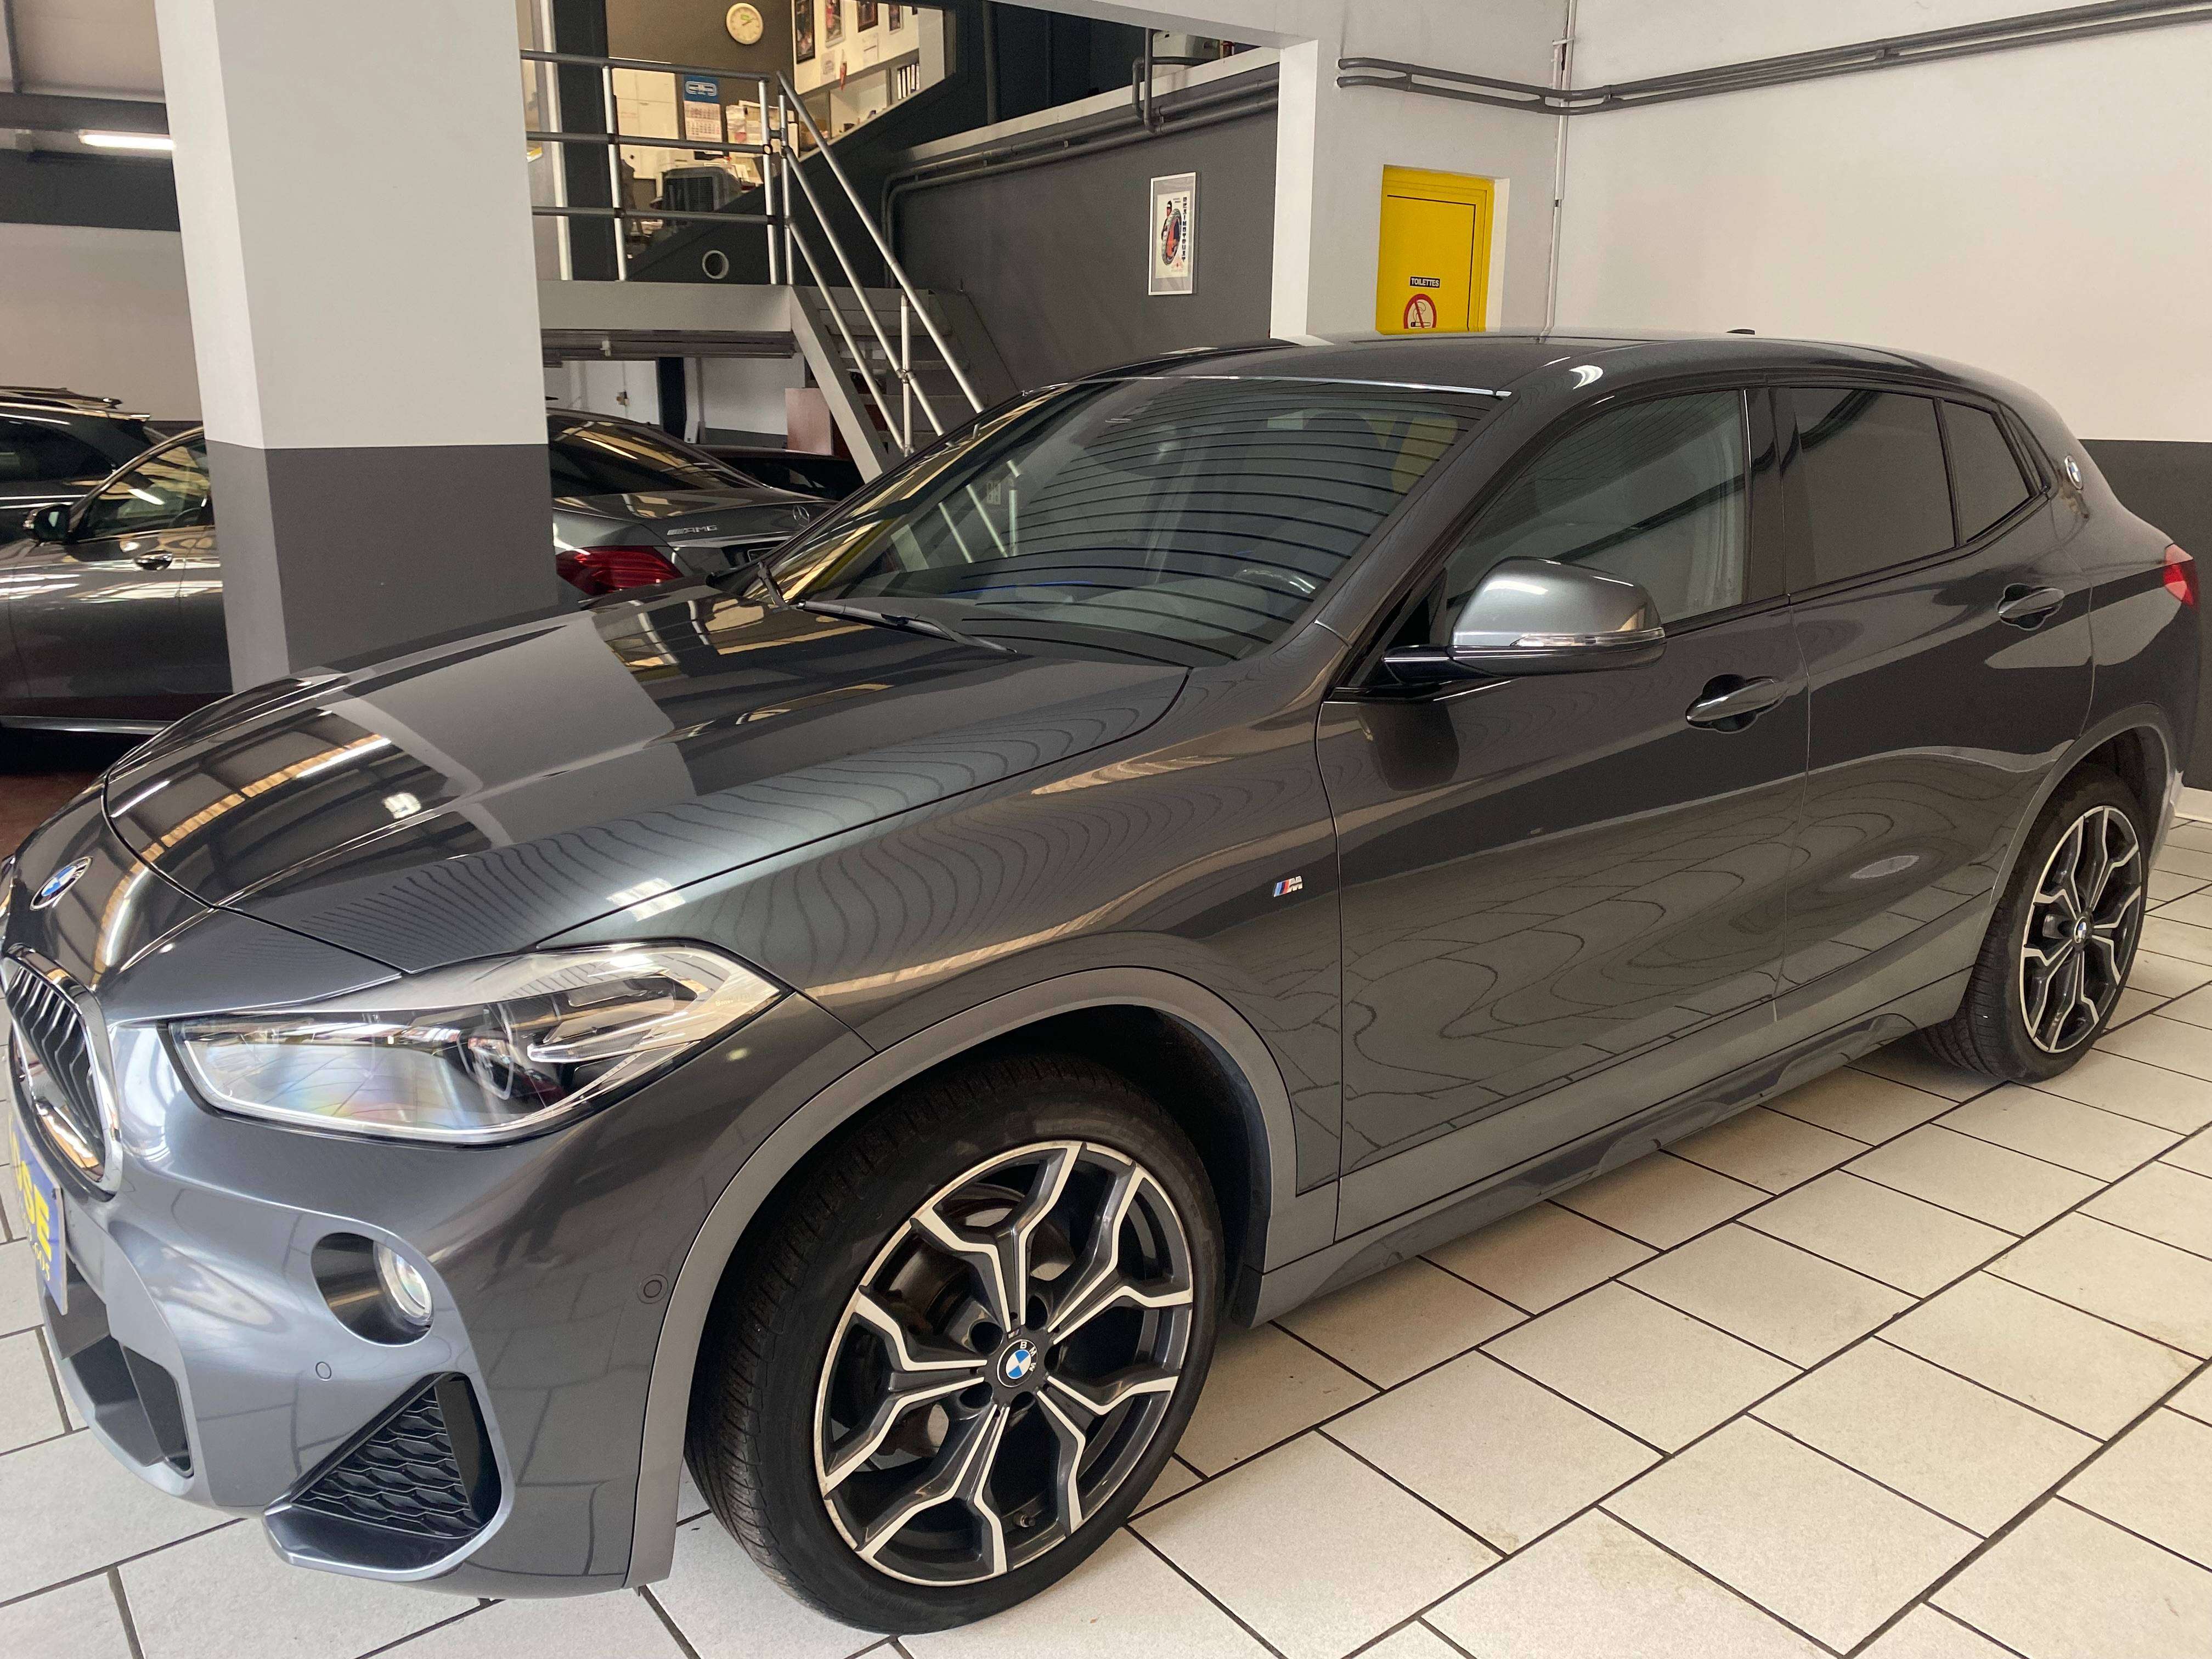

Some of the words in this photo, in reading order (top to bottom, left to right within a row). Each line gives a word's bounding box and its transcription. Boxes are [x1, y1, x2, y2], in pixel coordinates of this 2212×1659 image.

[1411, 277, 1439, 287] TOILETTES
[683, 525, 718, 534] AMG
[1020, 1341, 1037, 1372] BMW
